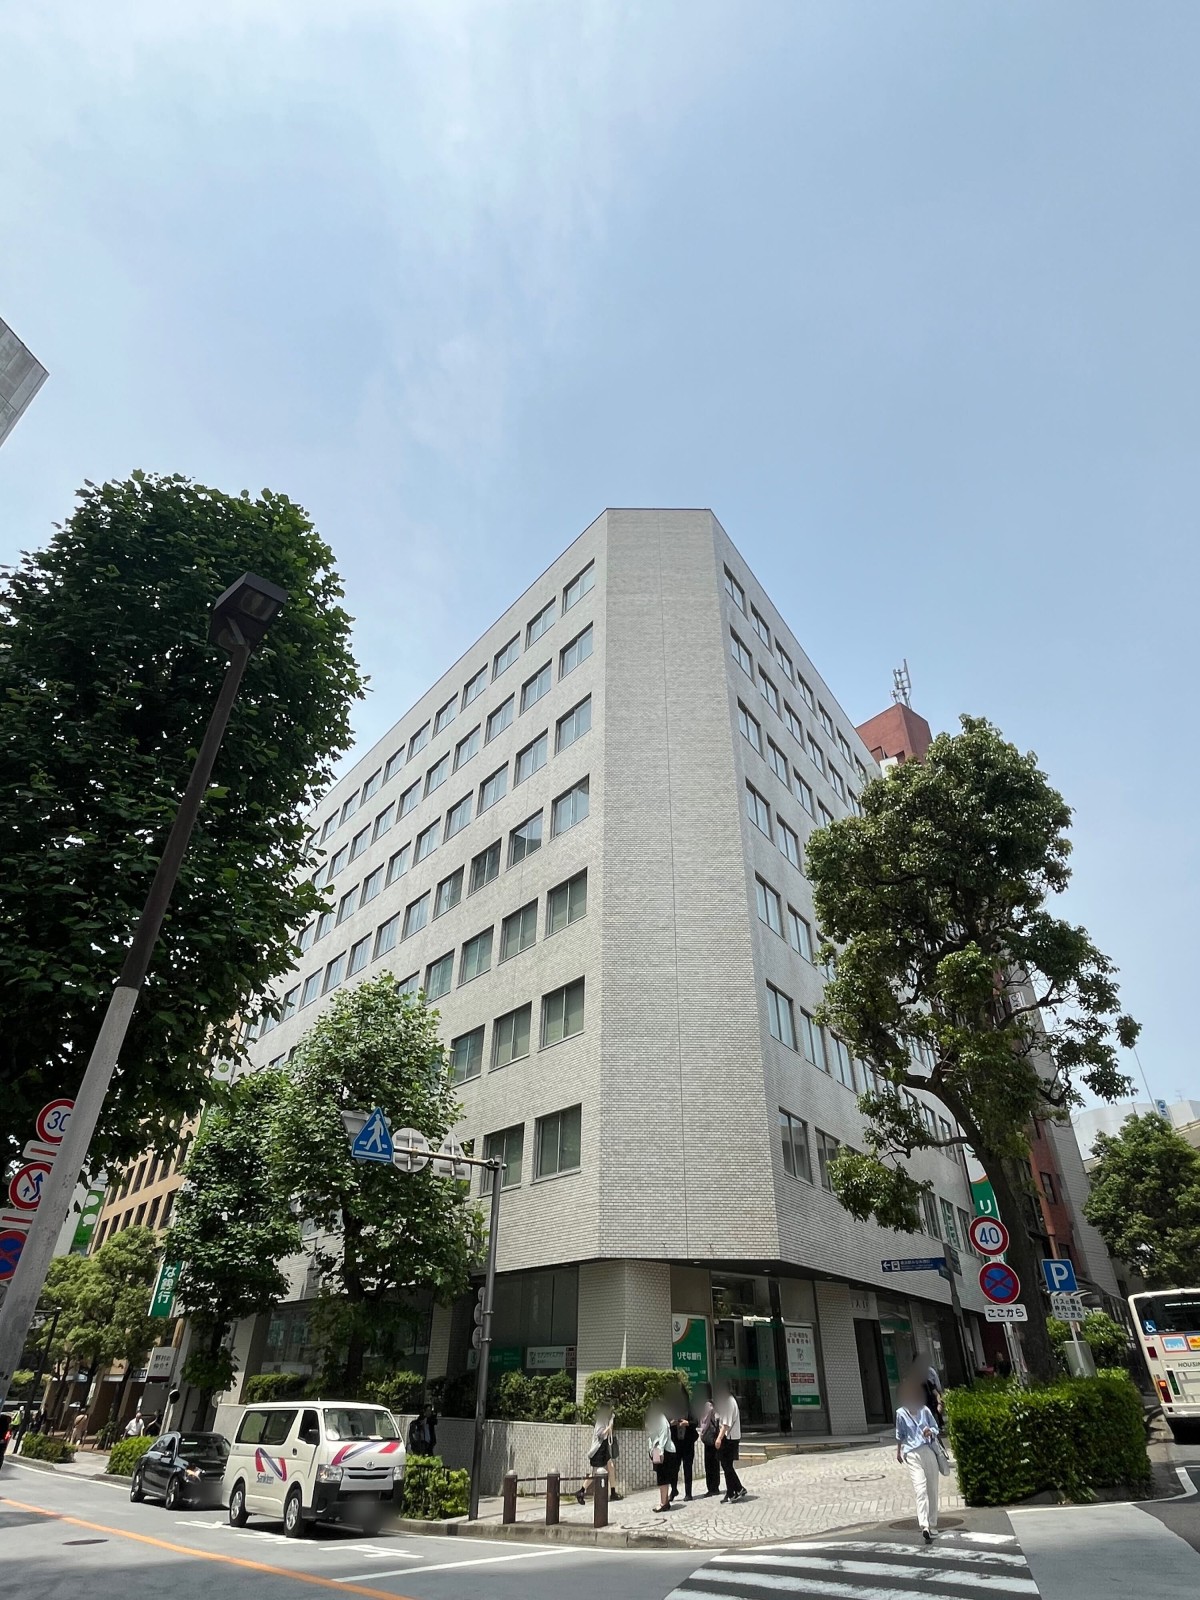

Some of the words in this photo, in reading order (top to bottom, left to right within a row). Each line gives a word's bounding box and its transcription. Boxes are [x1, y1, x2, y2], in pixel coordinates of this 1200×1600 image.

[980, 1227, 1000, 1245] 40
[1050, 1263, 1069, 1289] P
[987, 1308, 1024, 1318] ここから
[676, 1351, 702, 1361] りそな銀行
